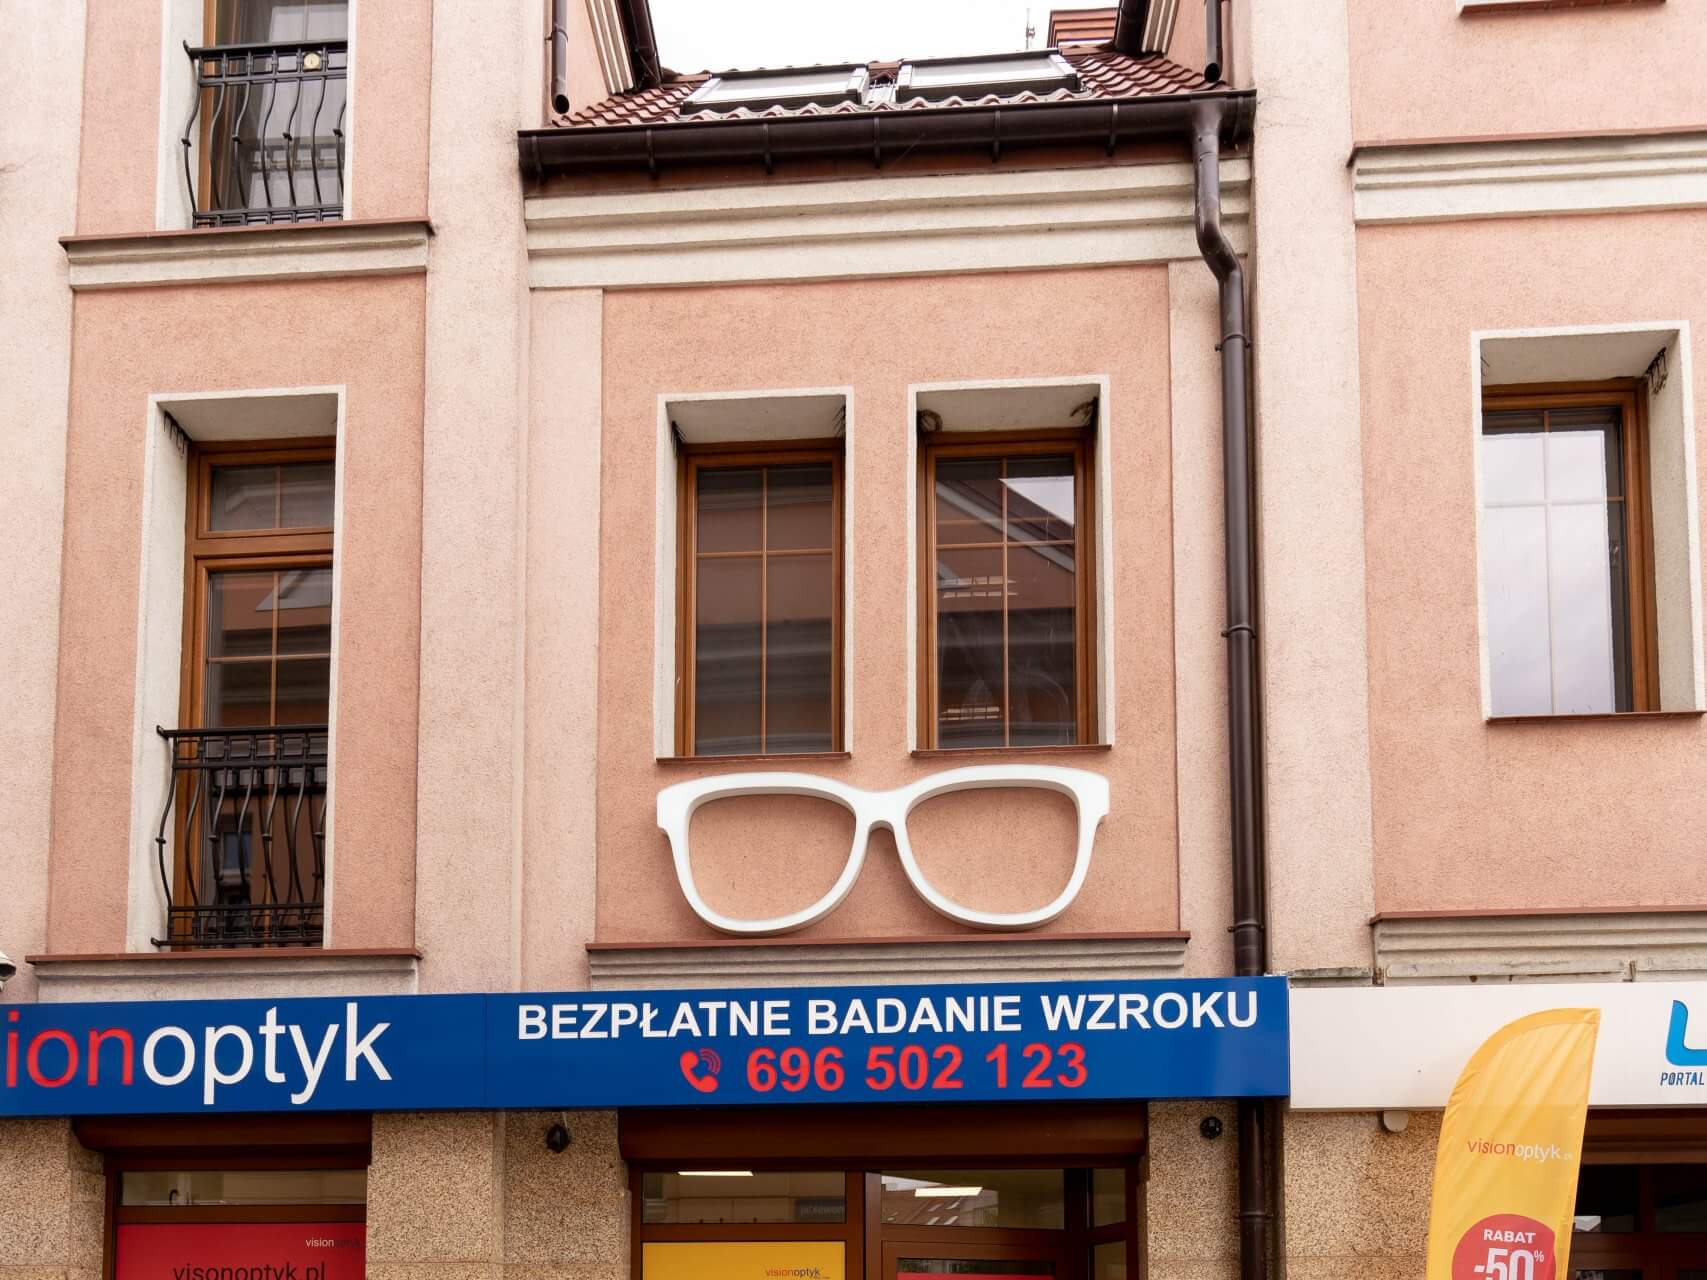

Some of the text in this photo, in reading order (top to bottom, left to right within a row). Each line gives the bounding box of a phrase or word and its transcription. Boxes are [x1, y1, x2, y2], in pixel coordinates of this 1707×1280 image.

[518, 991, 1258, 1041] BEZPŁATNE BADANIE WZROKU
[746, 1042, 1088, 1093] 696 502 123
[1660, 1072, 1705, 1086] PORTAL
[1483, 1229, 1536, 1243] RABAT
